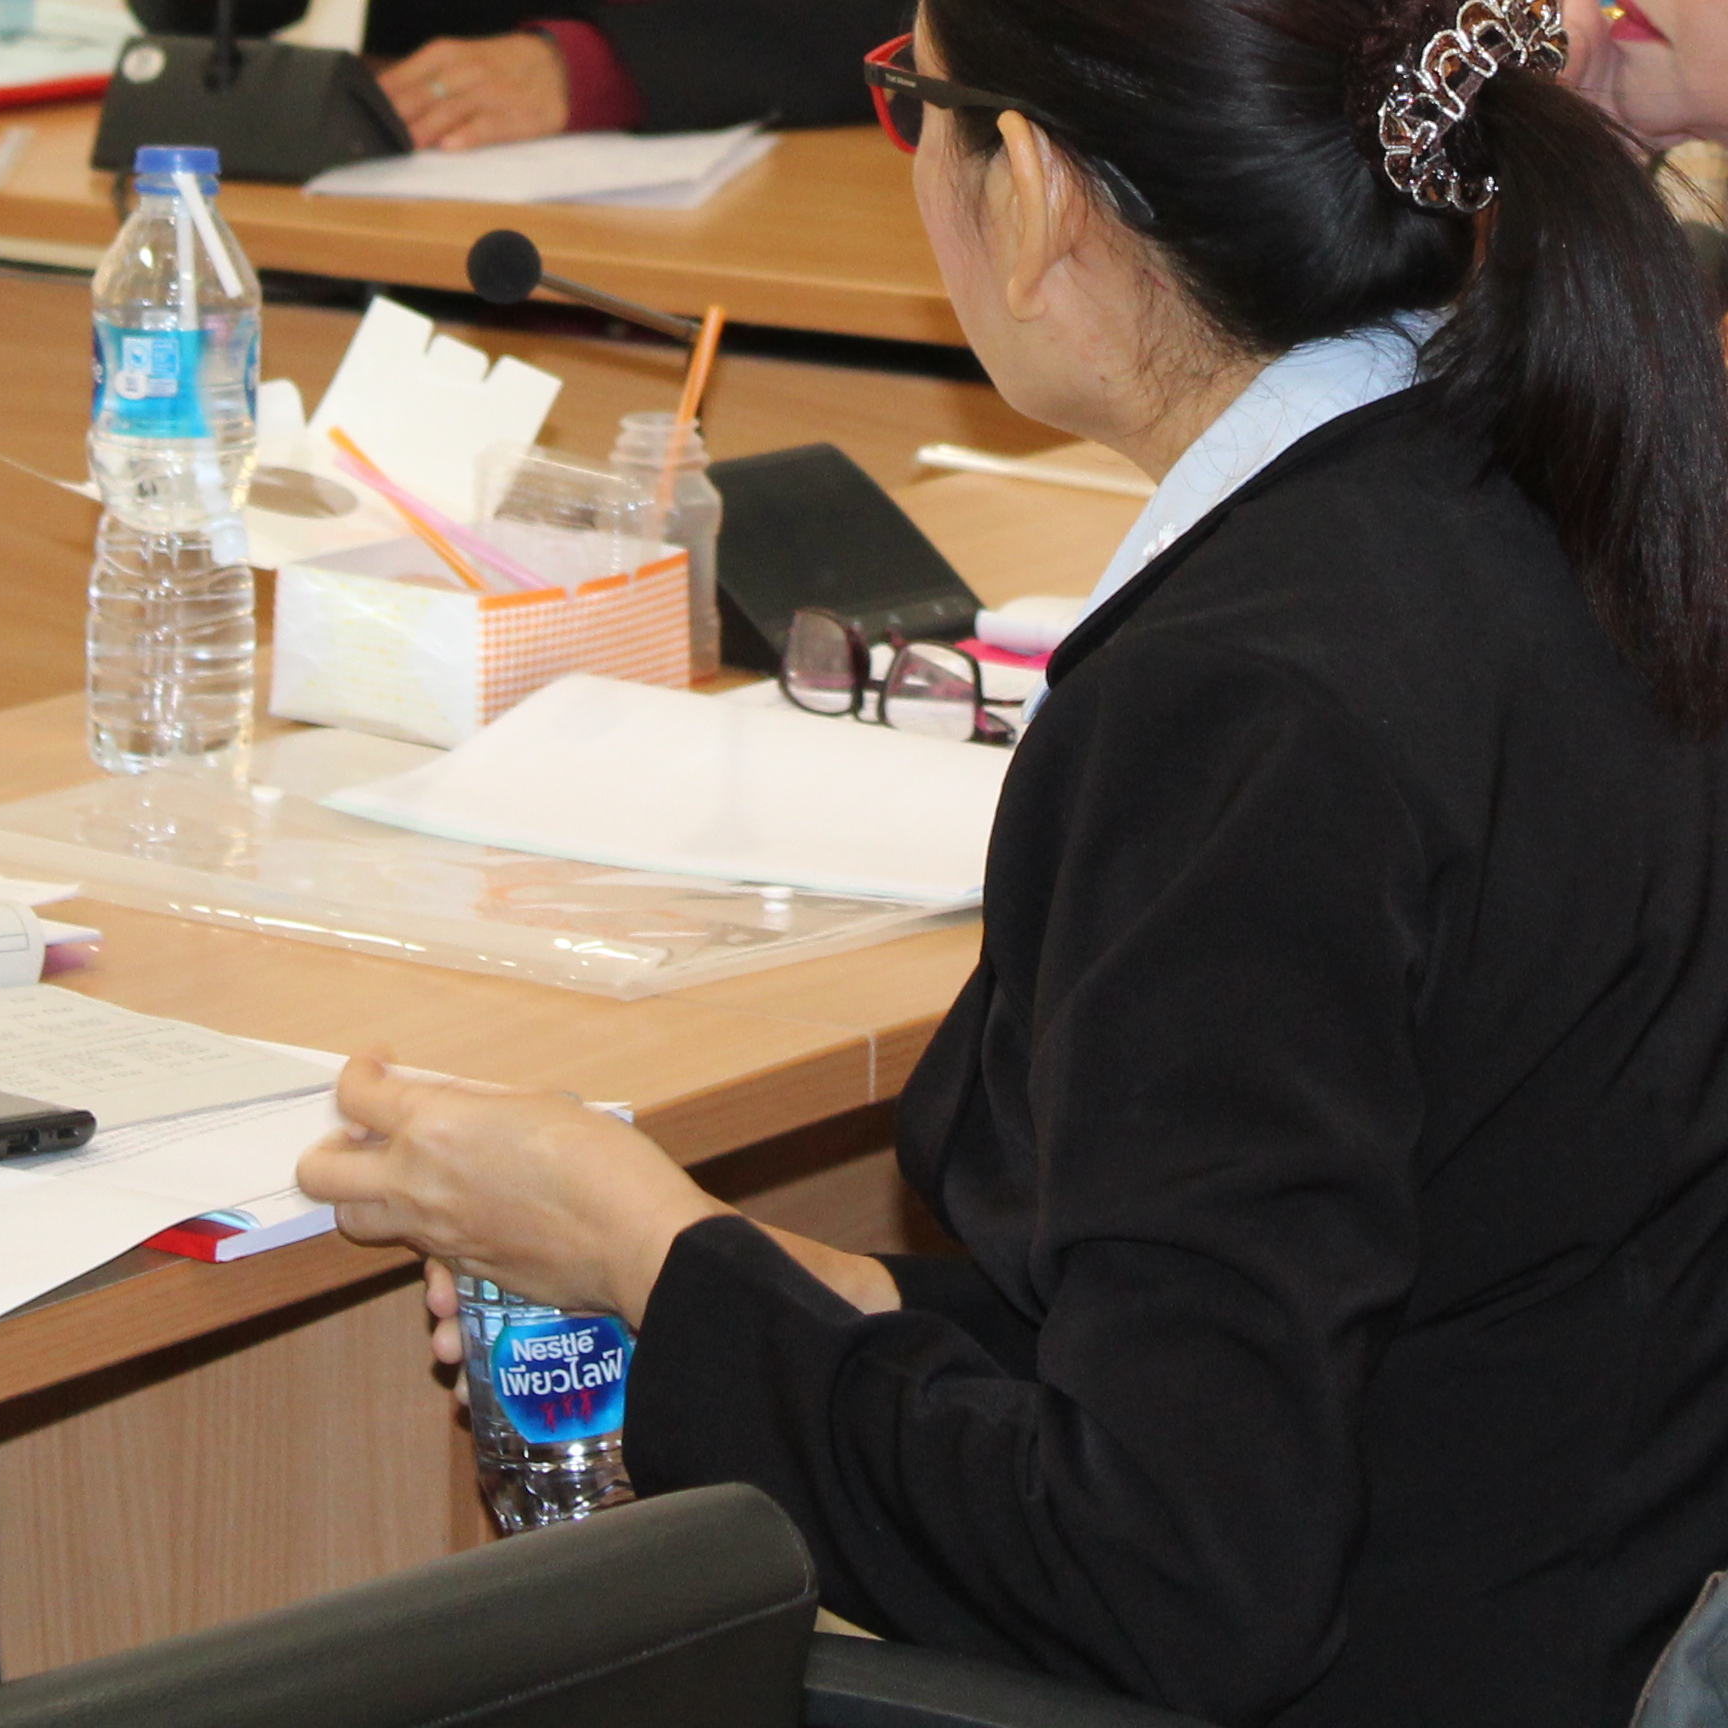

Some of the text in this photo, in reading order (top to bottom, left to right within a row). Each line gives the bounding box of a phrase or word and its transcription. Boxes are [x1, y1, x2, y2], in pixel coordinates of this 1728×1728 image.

[511, 1328, 595, 1362] Nestlé
[498, 1347, 624, 1397] เพียวไลฟ์
